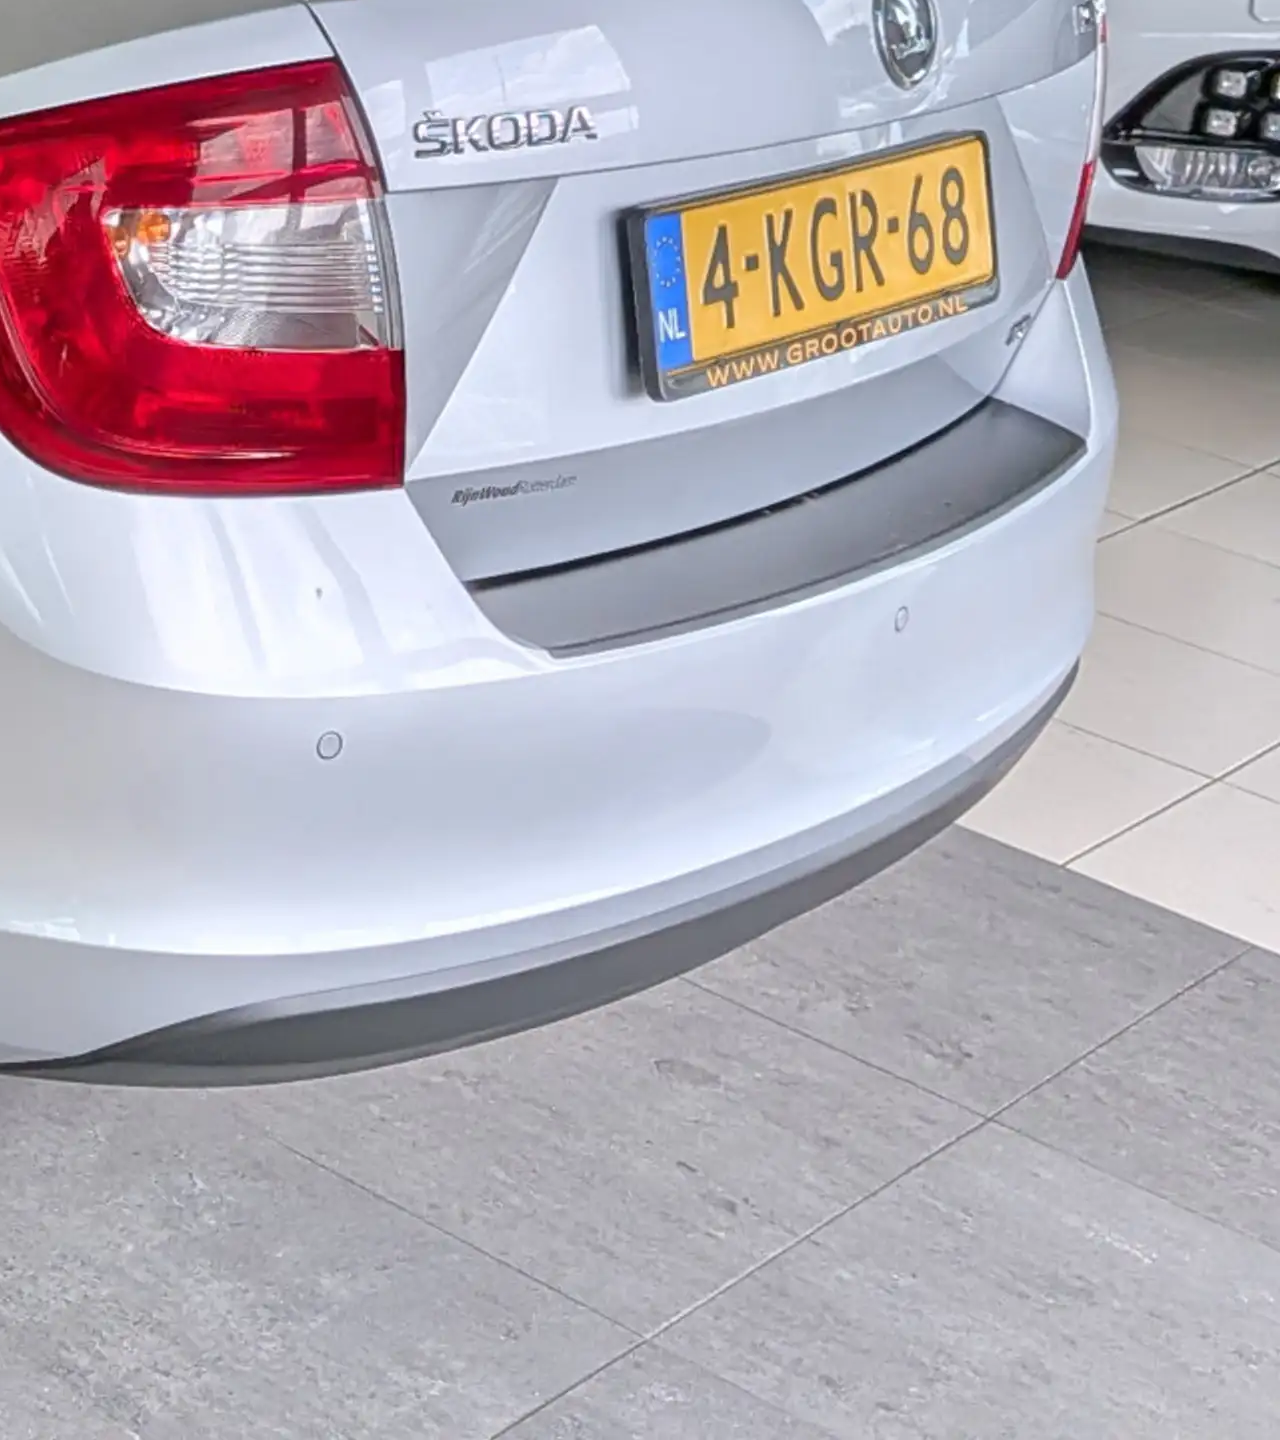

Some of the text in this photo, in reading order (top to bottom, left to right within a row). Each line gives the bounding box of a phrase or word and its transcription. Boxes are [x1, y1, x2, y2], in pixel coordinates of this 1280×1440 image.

[413, 106, 598, 158] ŠKODA
[702, 166, 969, 329] 4-KGR-68
[658, 308, 686, 344] NL
[706, 294, 969, 388] WWW.GROOTAUTO.NL
